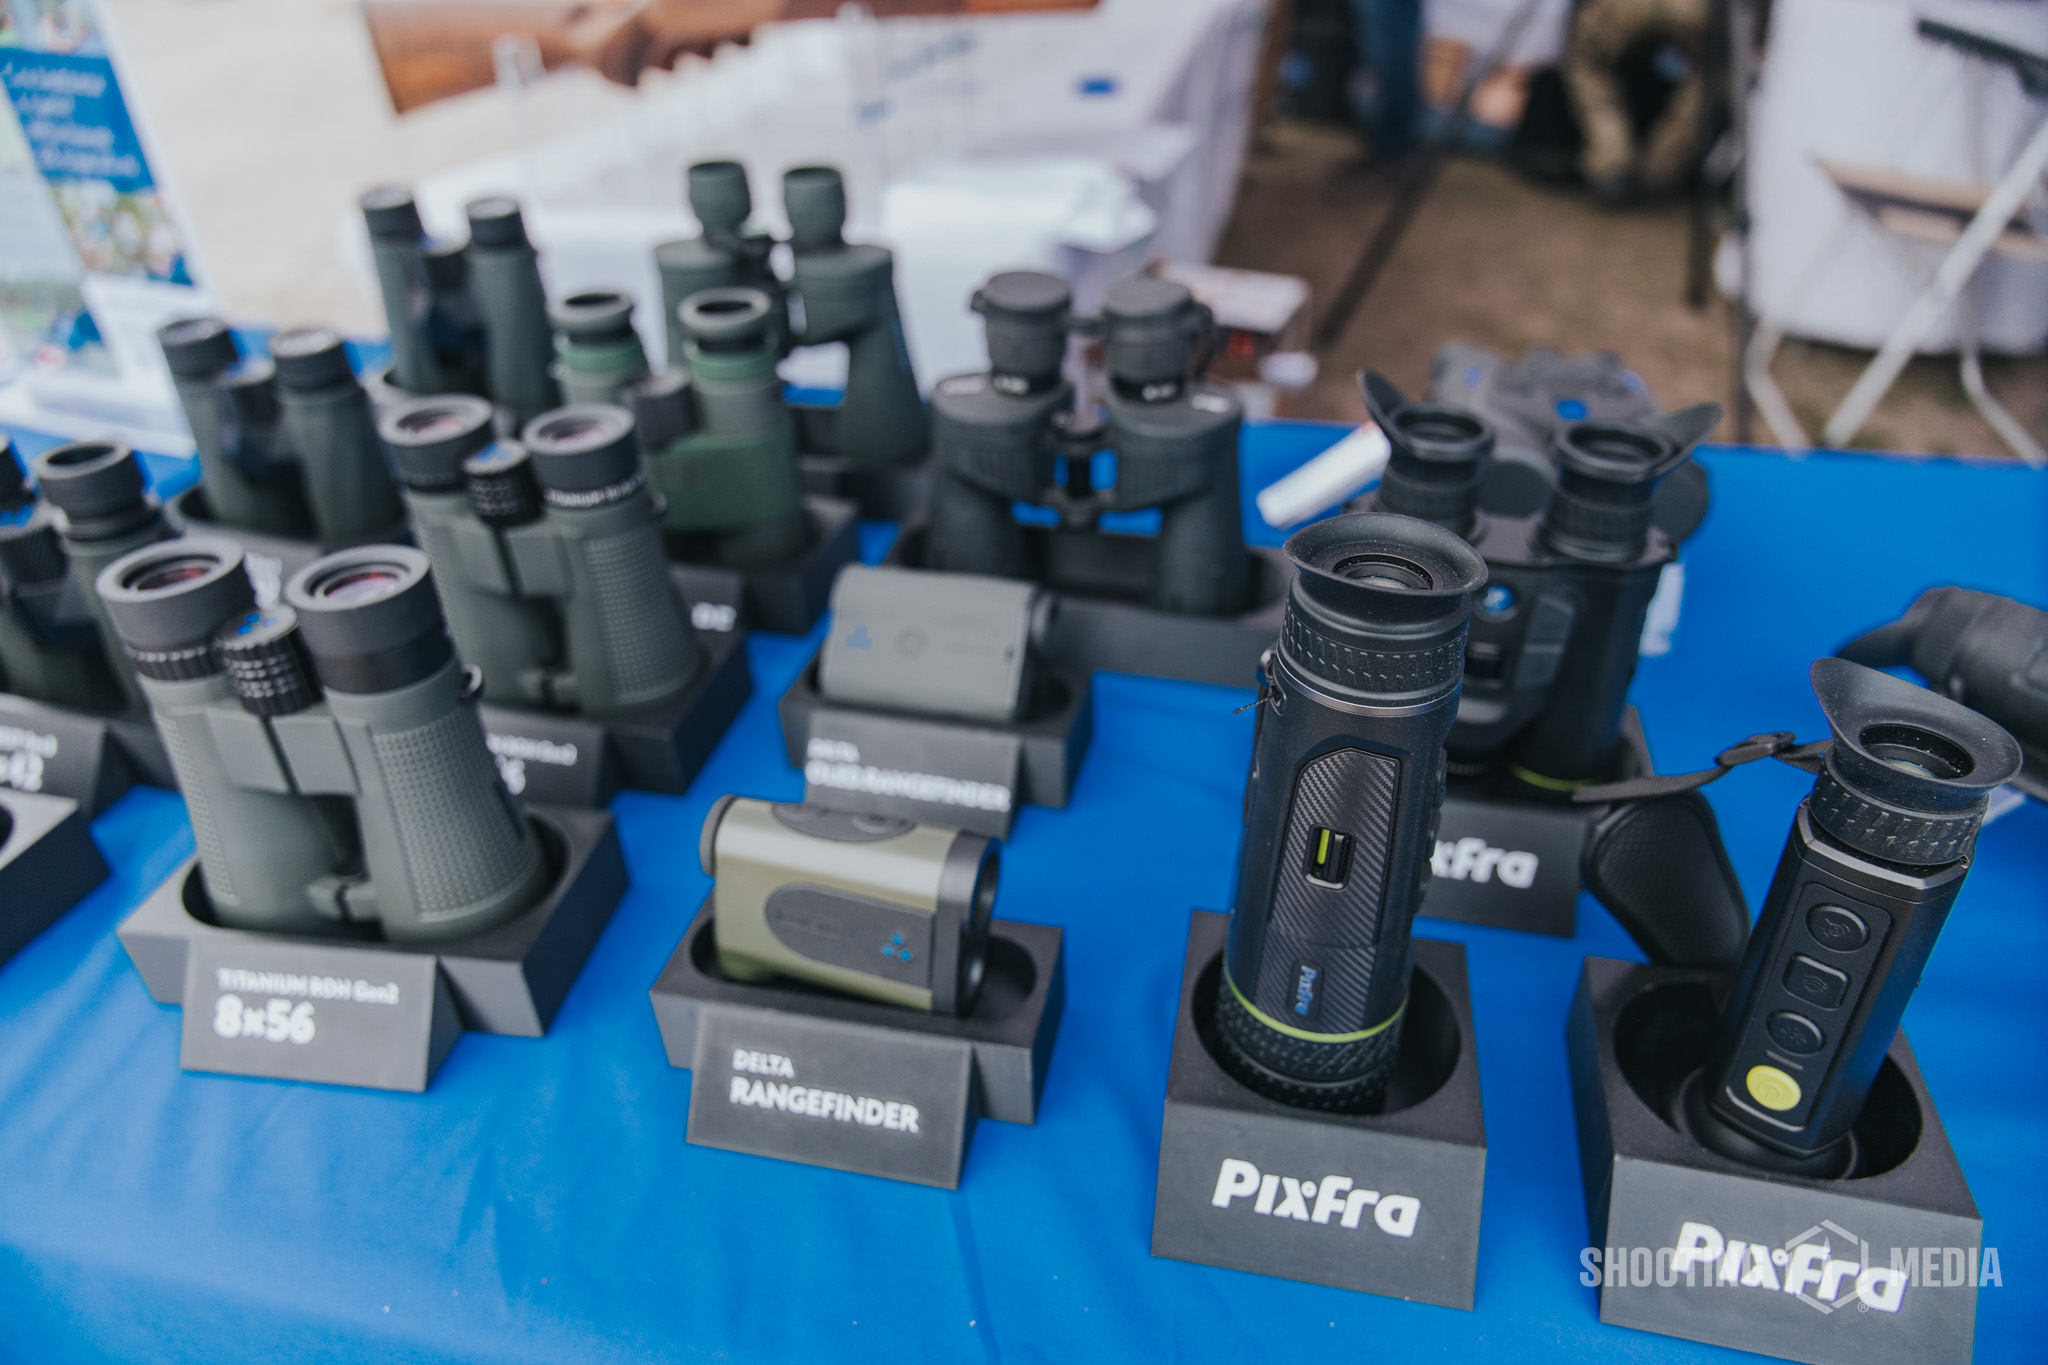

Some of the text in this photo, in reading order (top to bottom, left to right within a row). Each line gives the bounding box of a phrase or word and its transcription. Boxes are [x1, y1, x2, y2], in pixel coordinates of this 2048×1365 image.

[216, 968, 308, 996] TITANIUM
[732, 1048, 795, 1078] DELTA
[729, 1076, 920, 1134] RANGEFINDER
